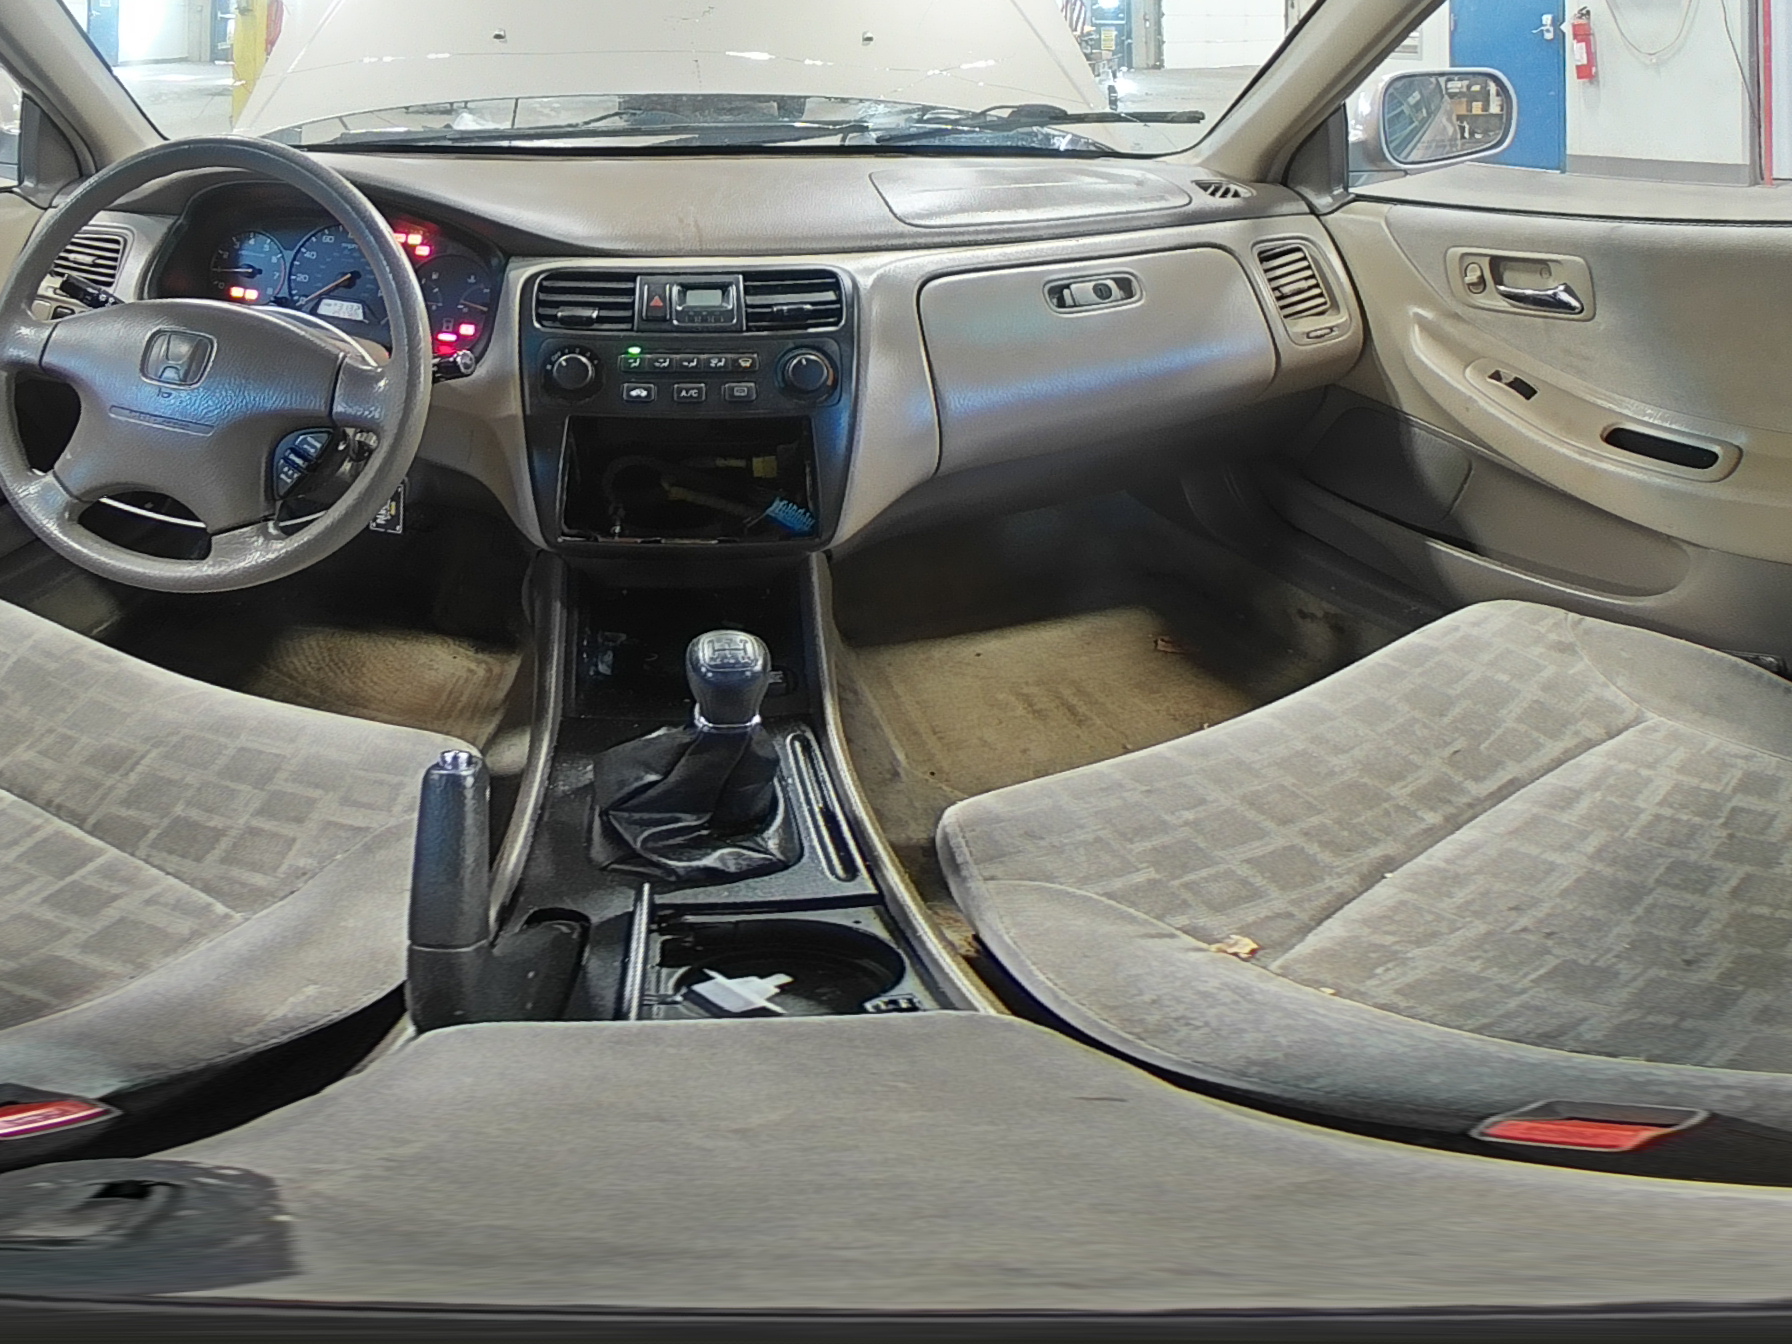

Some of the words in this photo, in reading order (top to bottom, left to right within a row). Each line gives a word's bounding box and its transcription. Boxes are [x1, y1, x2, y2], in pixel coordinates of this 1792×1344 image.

[322, 235, 335, 243] 60
[304, 251, 317, 260] 40
[296, 273, 309, 283] 20
[679, 389, 699, 397] A/C
